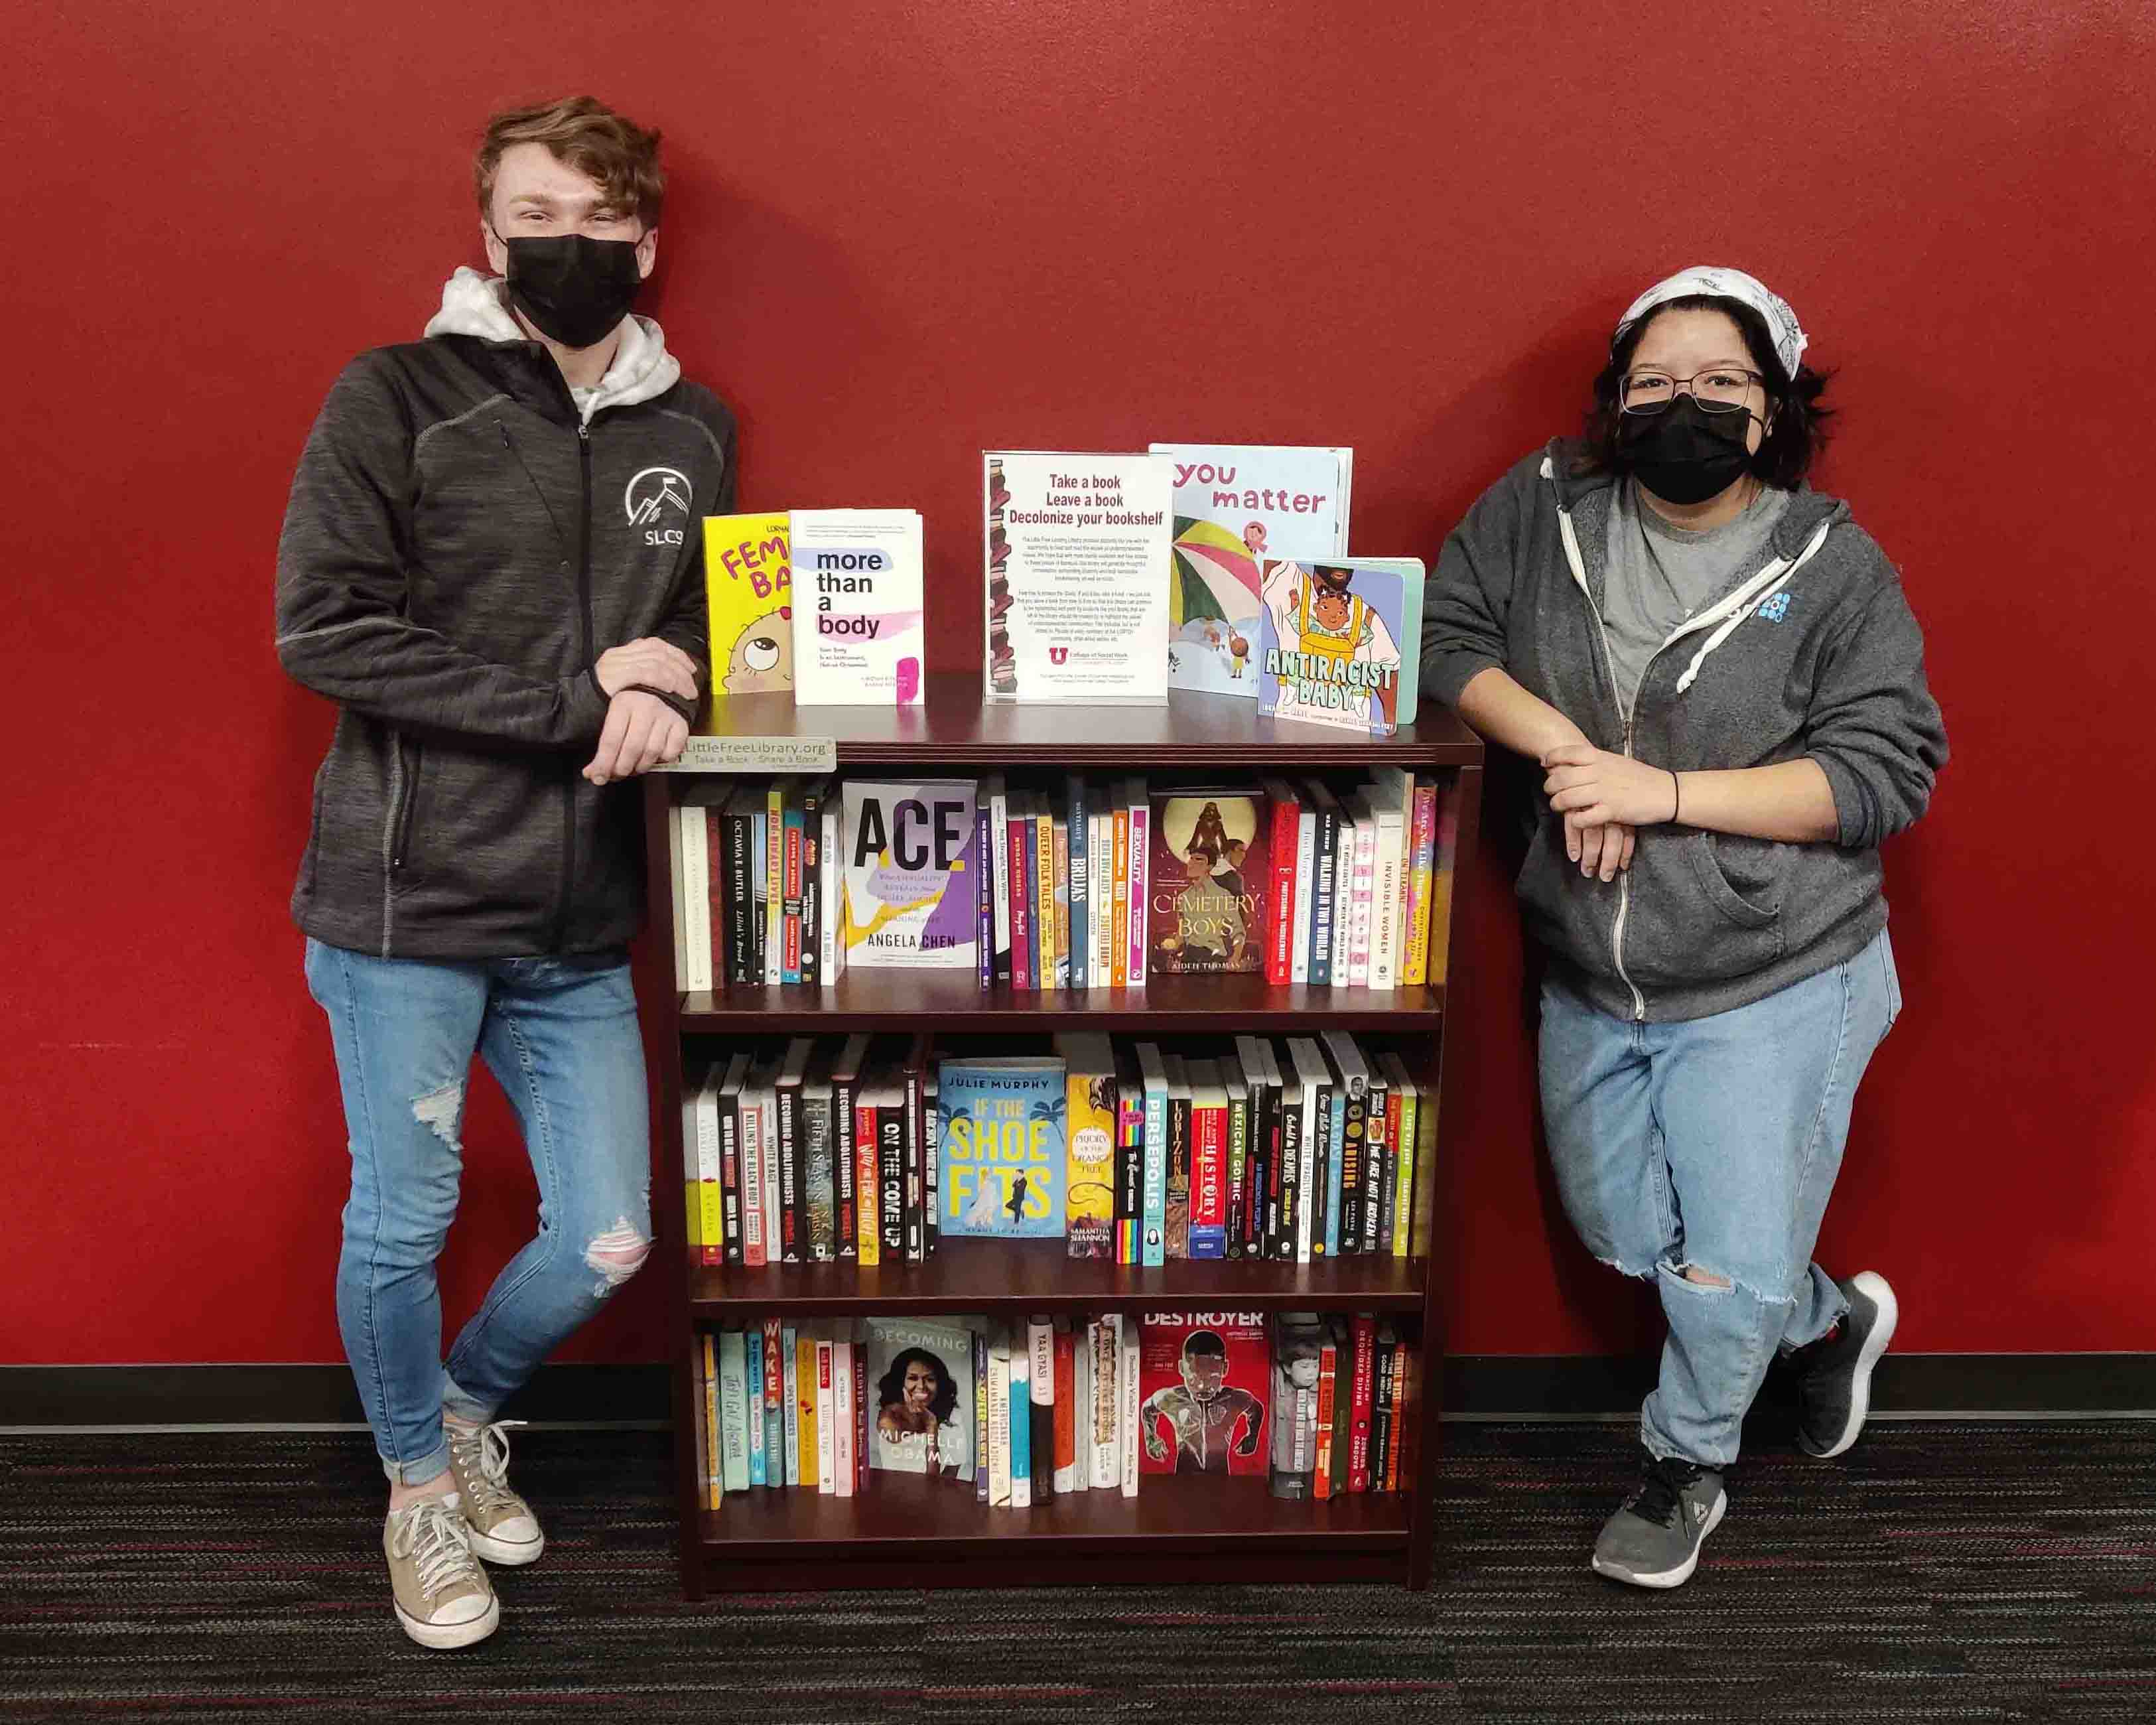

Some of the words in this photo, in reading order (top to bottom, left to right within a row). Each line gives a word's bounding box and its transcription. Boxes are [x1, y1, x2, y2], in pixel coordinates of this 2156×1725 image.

[1049, 474, 1077, 488] Take
[1082, 478, 1088, 488] a
[1093, 475, 1120, 488] book
[1173, 463, 1237, 487] you
[1047, 492, 1081, 506] Leave
[1085, 495, 1091, 506] a
[1095, 492, 1123, 507] book
[1213, 489, 1326, 514] matter
[1010, 510, 1073, 523] Decolonize
[1077, 514, 1103, 527] your
[1106, 511, 1163, 525] bookshelf
[817, 554, 882, 569] more
[816, 573, 872, 592] than
[818, 597, 831, 610] a
[818, 615, 880, 639] body
[1264, 648, 1396, 689] ANTIRACIST
[1298, 679, 1353, 711] BABY
[1421, 796, 1430, 810] We
[734, 820, 744, 858] OCTAVIA
[854, 797, 965, 870] ACE
[1040, 826, 1049, 856] QUEER
[1419, 831, 1428, 848] Not
[1133, 827, 1142, 884] SEXUALITY
[1040, 859, 1050, 881] FOLK
[1071, 857, 1087, 902] BRUJAS
[1318, 855, 1332, 893] WALKING
[735, 869, 744, 902] BUTLER
[1042, 883, 1051, 910] TALES
[1382, 861, 1393, 912] INVISIBLE
[1153, 894, 1260, 914] CEMETERY
[1317, 907, 1330, 924] TWO
[1179, 917, 1233, 937] BOYS
[1381, 916, 1390, 955] WOMEN
[867, 934, 916, 947] ANGELA
[921, 935, 955, 948] CHEN
[949, 1077, 986, 1089] JULIE
[990, 1080, 1051, 1090] MURPHY
[781, 1094, 792, 1139] BECOMING
[839, 1088, 850, 1133] BECOMING
[975, 1099, 988, 1116] IF
[994, 1099, 1025, 1117] THE
[746, 1114, 757, 1144] KILLING
[812, 1119, 824, 1154] FIFTH
[884, 1123, 900, 1144] ON
[949, 1117, 1051, 1161] SHOE
[1233, 1103, 1243, 1154] MEXICAN
[748, 1146, 758, 1160] THE
[766, 1136, 775, 1160] WHITE
[1146, 1099, 1161, 1209] PERSEPOLIS
[1303, 1136, 1312, 1159] WHITE
[1370, 1146, 1381, 1159] WE
[748, 1161, 758, 1184] BLACK
[768, 1163, 777, 1184] RAGE
[781, 1141, 794, 1205] ABOLITIONISTS
[840, 1135, 851, 1198] ABOLITIONISTS
[885, 1149, 900, 1176] THE
[1283, 1148, 1296, 1183] DREAMERS
[1369, 1161, 1381, 1178] ARE
[812, 1154, 824, 1201] SEASON
[1203, 1144, 1217, 1217] HISTORY
[1232, 1160, 1241, 1201] GOTHIC
[1302, 1161, 1312, 1198] FRAGILITY
[1367, 1180, 1379, 1199] NOT
[748, 1186, 759, 1206] BODY
[884, 1180, 900, 1222] COME
[949, 1165, 1052, 1219] FITS
[1366, 1202, 1379, 1237] BROKEN
[885, 1228, 900, 1247] UP
[1144, 1312, 1263, 1326] DESTROYER
[872, 1328, 967, 1351] BECOMING
[1038, 1334, 1046, 1352] YAA
[764, 1320, 781, 1391] WAKE
[1356, 1377, 1365, 1407] DIVINA
[879, 1428, 964, 1448] MICHELLE
[891, 1447, 954, 1466] OBAMA
